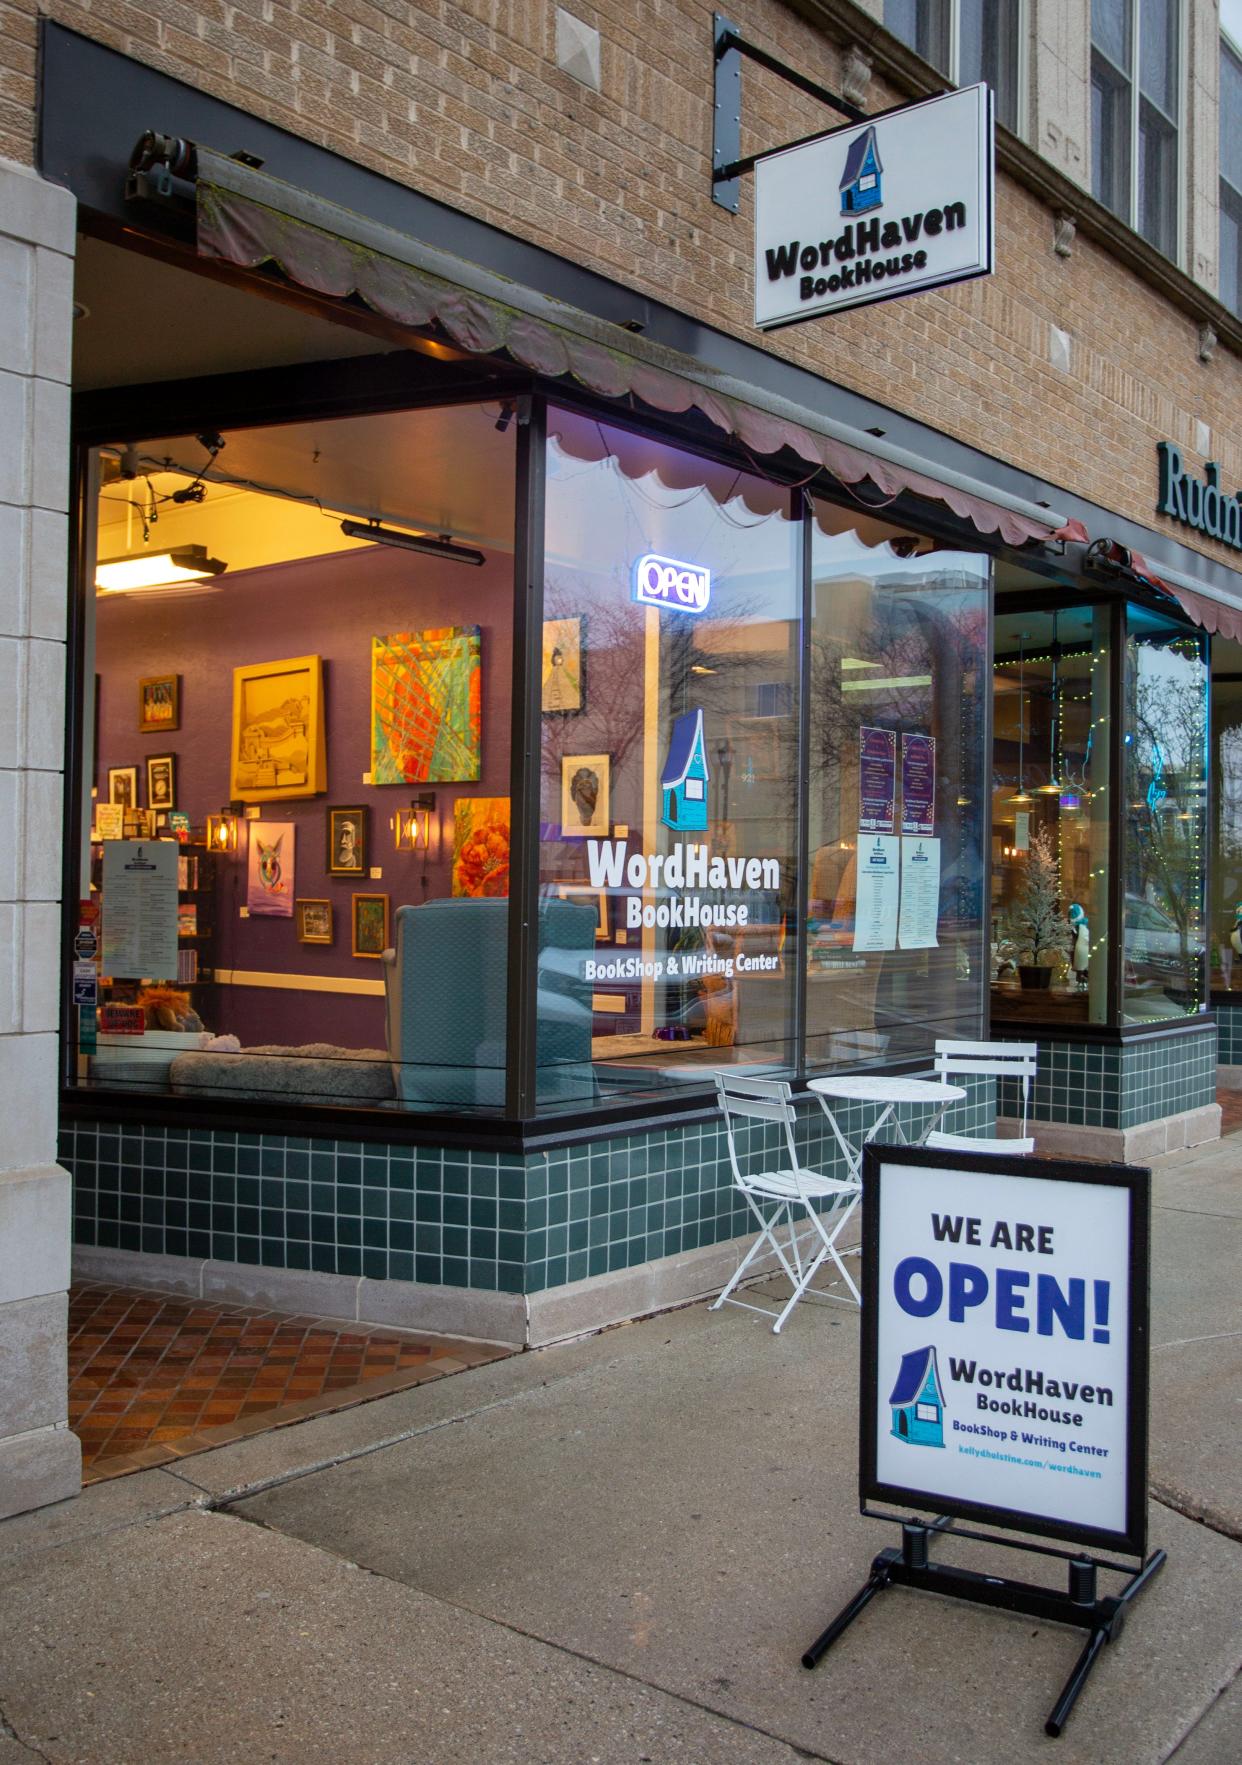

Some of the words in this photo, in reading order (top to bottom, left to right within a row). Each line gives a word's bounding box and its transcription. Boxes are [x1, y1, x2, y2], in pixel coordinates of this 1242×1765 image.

[765, 201, 966, 281] WordHaven
[800, 250, 927, 300] BookHouse
[1156, 441, 1242, 553] Rudn
[642, 562, 705, 608] OPEN
[586, 840, 780, 889] WordHaven
[626, 896, 748, 929] BookHouse
[585, 956, 663, 981] BookShop
[666, 956, 679, 975] &
[681, 953, 734, 977] Writing
[735, 953, 778, 971] Center
[931, 1213, 981, 1246] WE
[990, 1221, 1054, 1254] ARE
[893, 1256, 1110, 1344] OPEN!
[949, 1357, 1113, 1406] WordHaven
[976, 1393, 1083, 1426] BookHouse
[952, 1420, 1008, 1441] BookShop
[1010, 1430, 1019, 1441] &
[1021, 1432, 1066, 1452] Writing
[1069, 1441, 1109, 1457] Center
